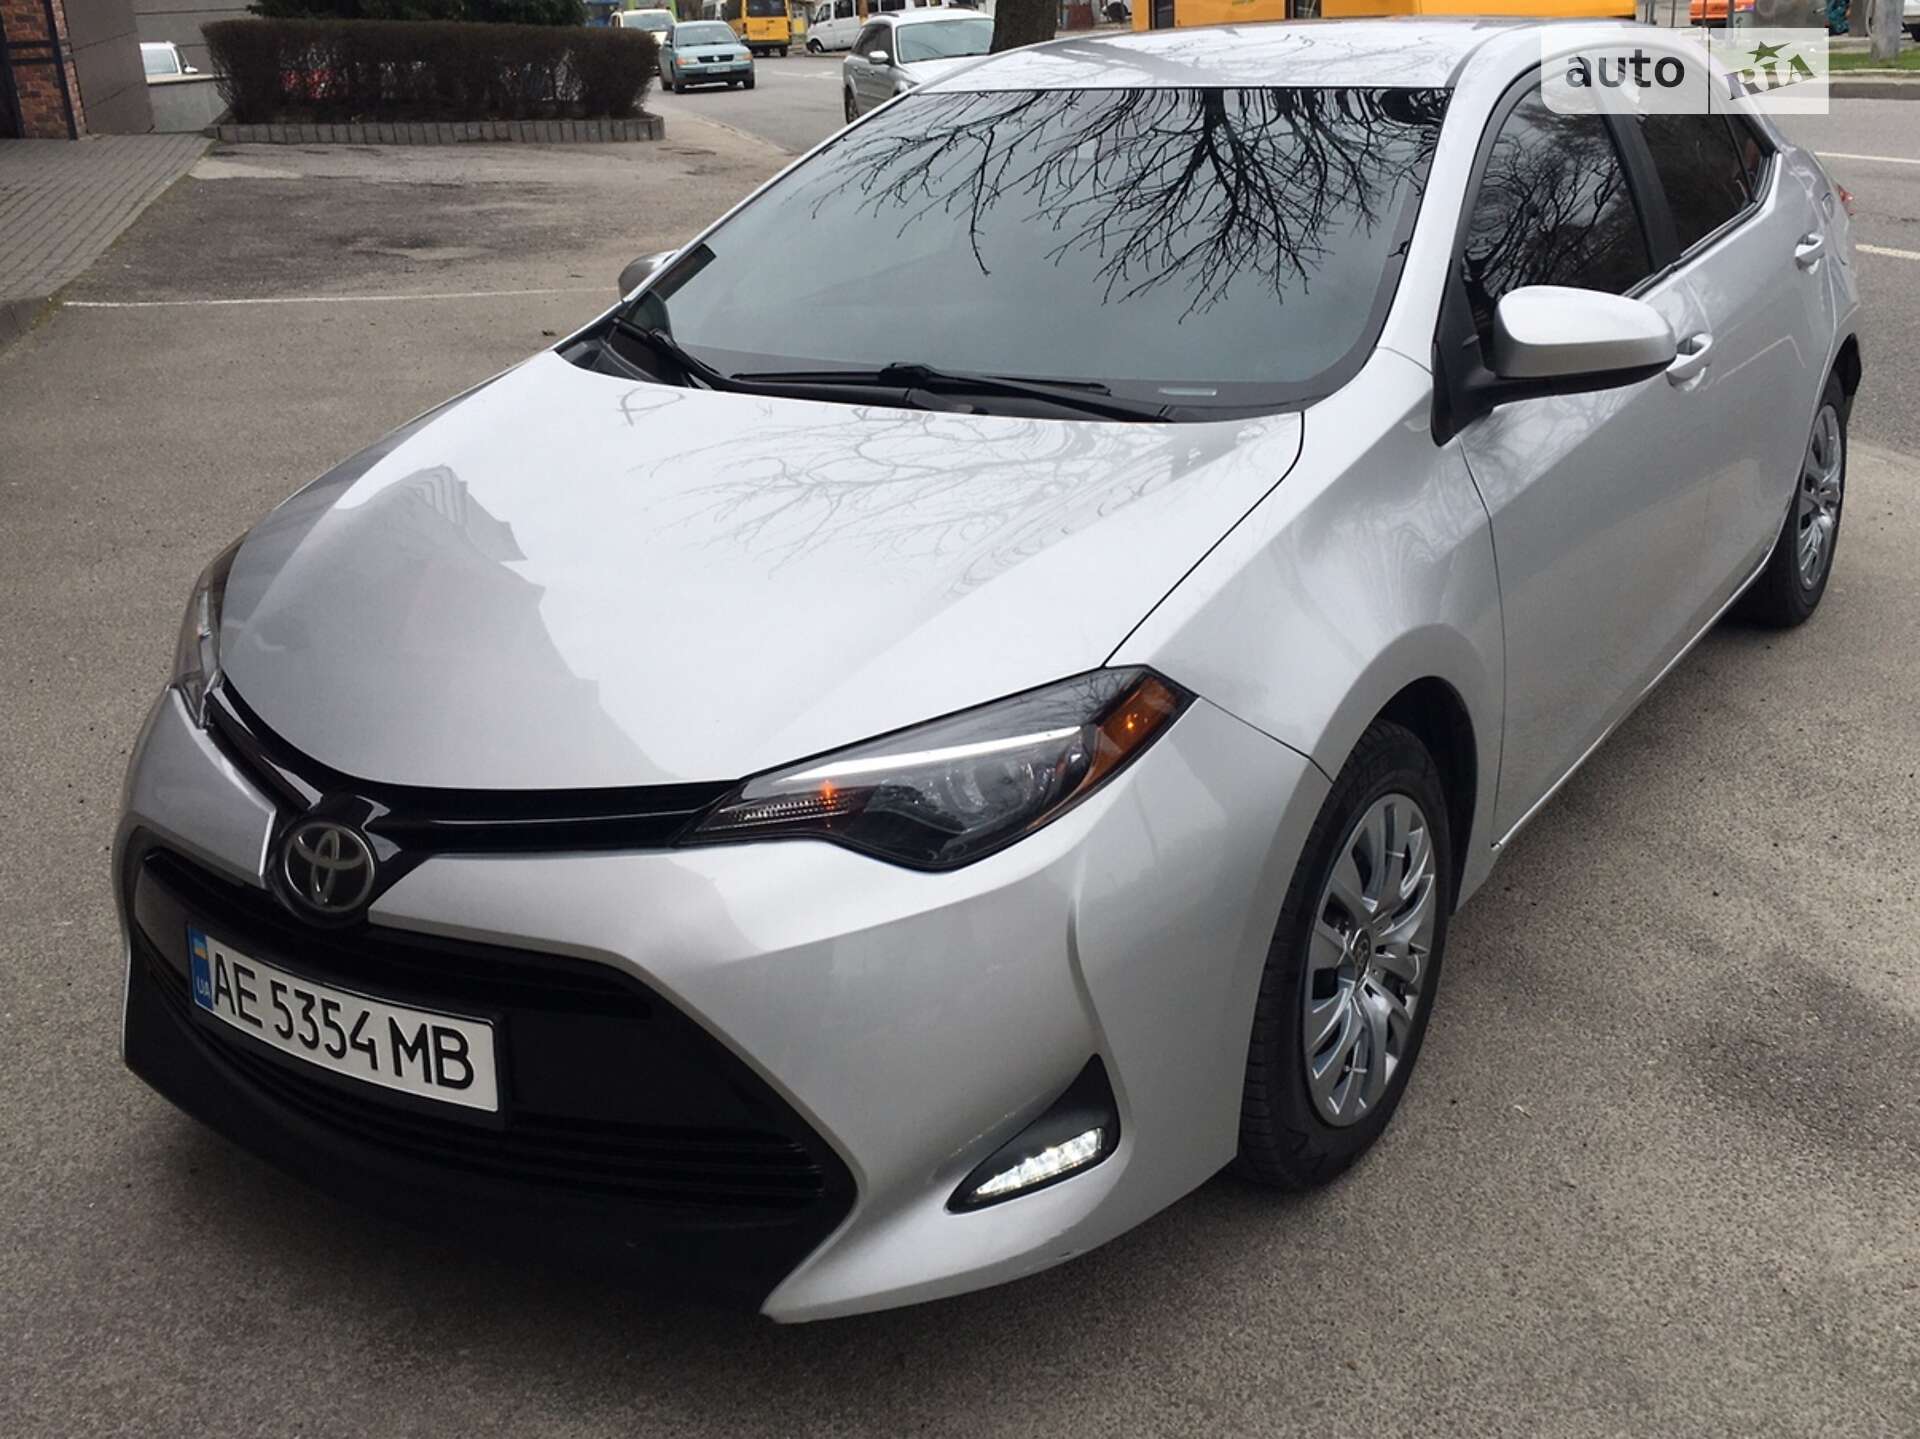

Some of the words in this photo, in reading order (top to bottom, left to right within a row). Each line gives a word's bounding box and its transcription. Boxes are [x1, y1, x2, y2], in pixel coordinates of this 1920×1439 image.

[214, 952, 263, 1028] AE
[270, 979, 379, 1071] 5354
[388, 1016, 475, 1090] MB
